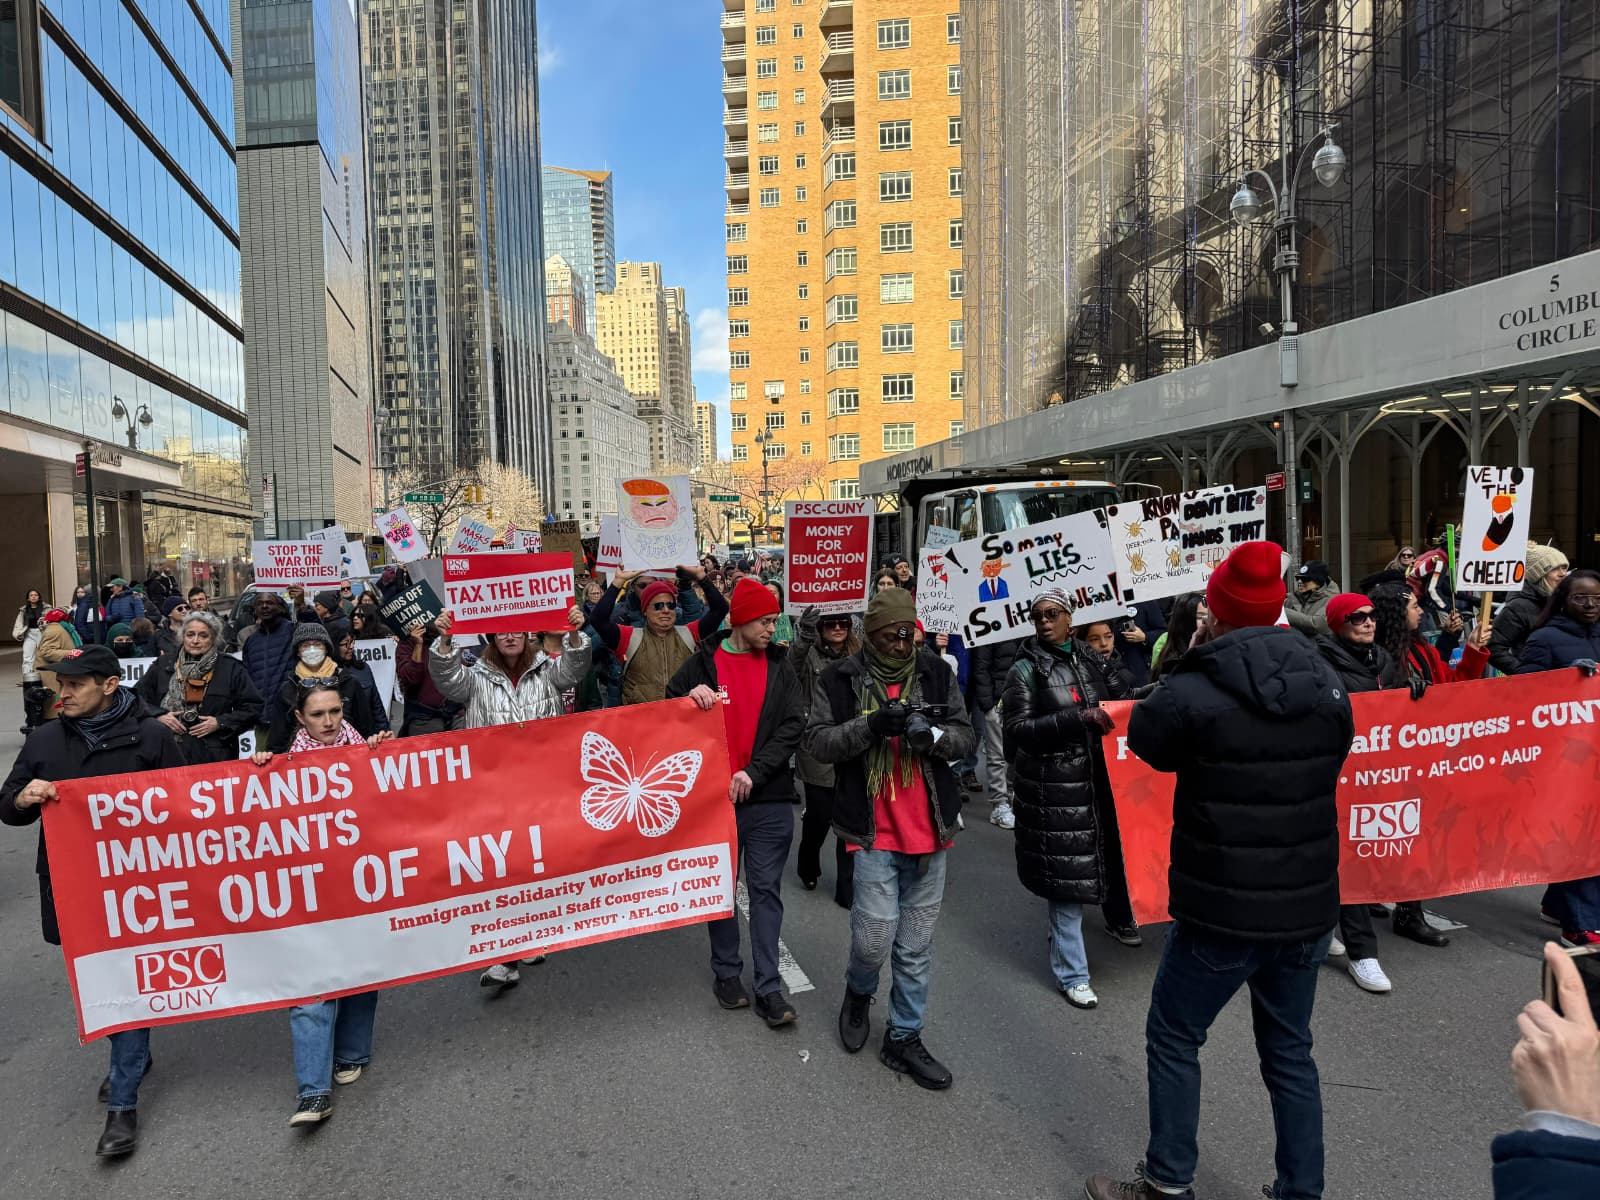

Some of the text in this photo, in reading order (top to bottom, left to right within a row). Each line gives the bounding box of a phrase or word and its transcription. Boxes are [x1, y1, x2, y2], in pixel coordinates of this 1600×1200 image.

[1550, 274, 1560, 292] 5
[1517, 319, 1596, 351] CIRCLE
[887, 454, 933, 480] NORDSTROM
[1471, 467, 1524, 485] VETO
[1226, 490, 1257, 513] BITE
[1482, 484, 1516, 499] THE
[795, 502, 865, 515] PSC-CUNY
[461, 527, 490, 545] MASKS
[470, 521, 483, 533] NO
[805, 525, 853, 537] MONEY
[1182, 520, 1264, 549] HANDS THAT
[267, 544, 323, 556] STOP THE
[463, 537, 478, 547] NO
[816, 540, 842, 551] FOR
[981, 532, 1063, 561] So many
[274, 556, 320, 567] WAR ON
[448, 559, 468, 570] PSC
[792, 552, 865, 565] EDUCATION
[257, 566, 338, 578] UNIVERSITIES!
[815, 567, 842, 579] NOT
[1463, 560, 1525, 584] CHEETO
[447, 574, 572, 605] TAX THE RICH
[791, 579, 863, 593] OLIGARCHS
[917, 590, 951, 603] PEOPL
[380, 584, 424, 619] HANDS OFF
[462, 597, 558, 616] FOR AN AFFORDABLE NY
[395, 602, 422, 623] LATIN
[1350, 725, 1392, 754] aff
[1398, 715, 1510, 748] Congress
[1354, 745, 1542, 787] NYSUT AFL-CIO AAUP
[87, 744, 472, 830] PSC STANDS WITH
[1351, 801, 1419, 839] PSC
[96, 809, 361, 878] IMMIGRANTS
[1357, 838, 1414, 858] CUNY
[103, 881, 195, 938] ICE
[218, 863, 324, 923] OUT
[352, 847, 419, 903] OF
[388, 853, 720, 933] Immigrant Solidarity Working Group
[470, 905, 562, 937] Professional
[566, 896, 601, 916] Staff
[604, 885, 670, 908] Congress
[680, 874, 722, 894] CUNY
[468, 894, 724, 955] AFT Local 2334 NYSUT AFL-CIO AAUP
[137, 945, 225, 994] PSC
[149, 986, 219, 1013] CUNY
